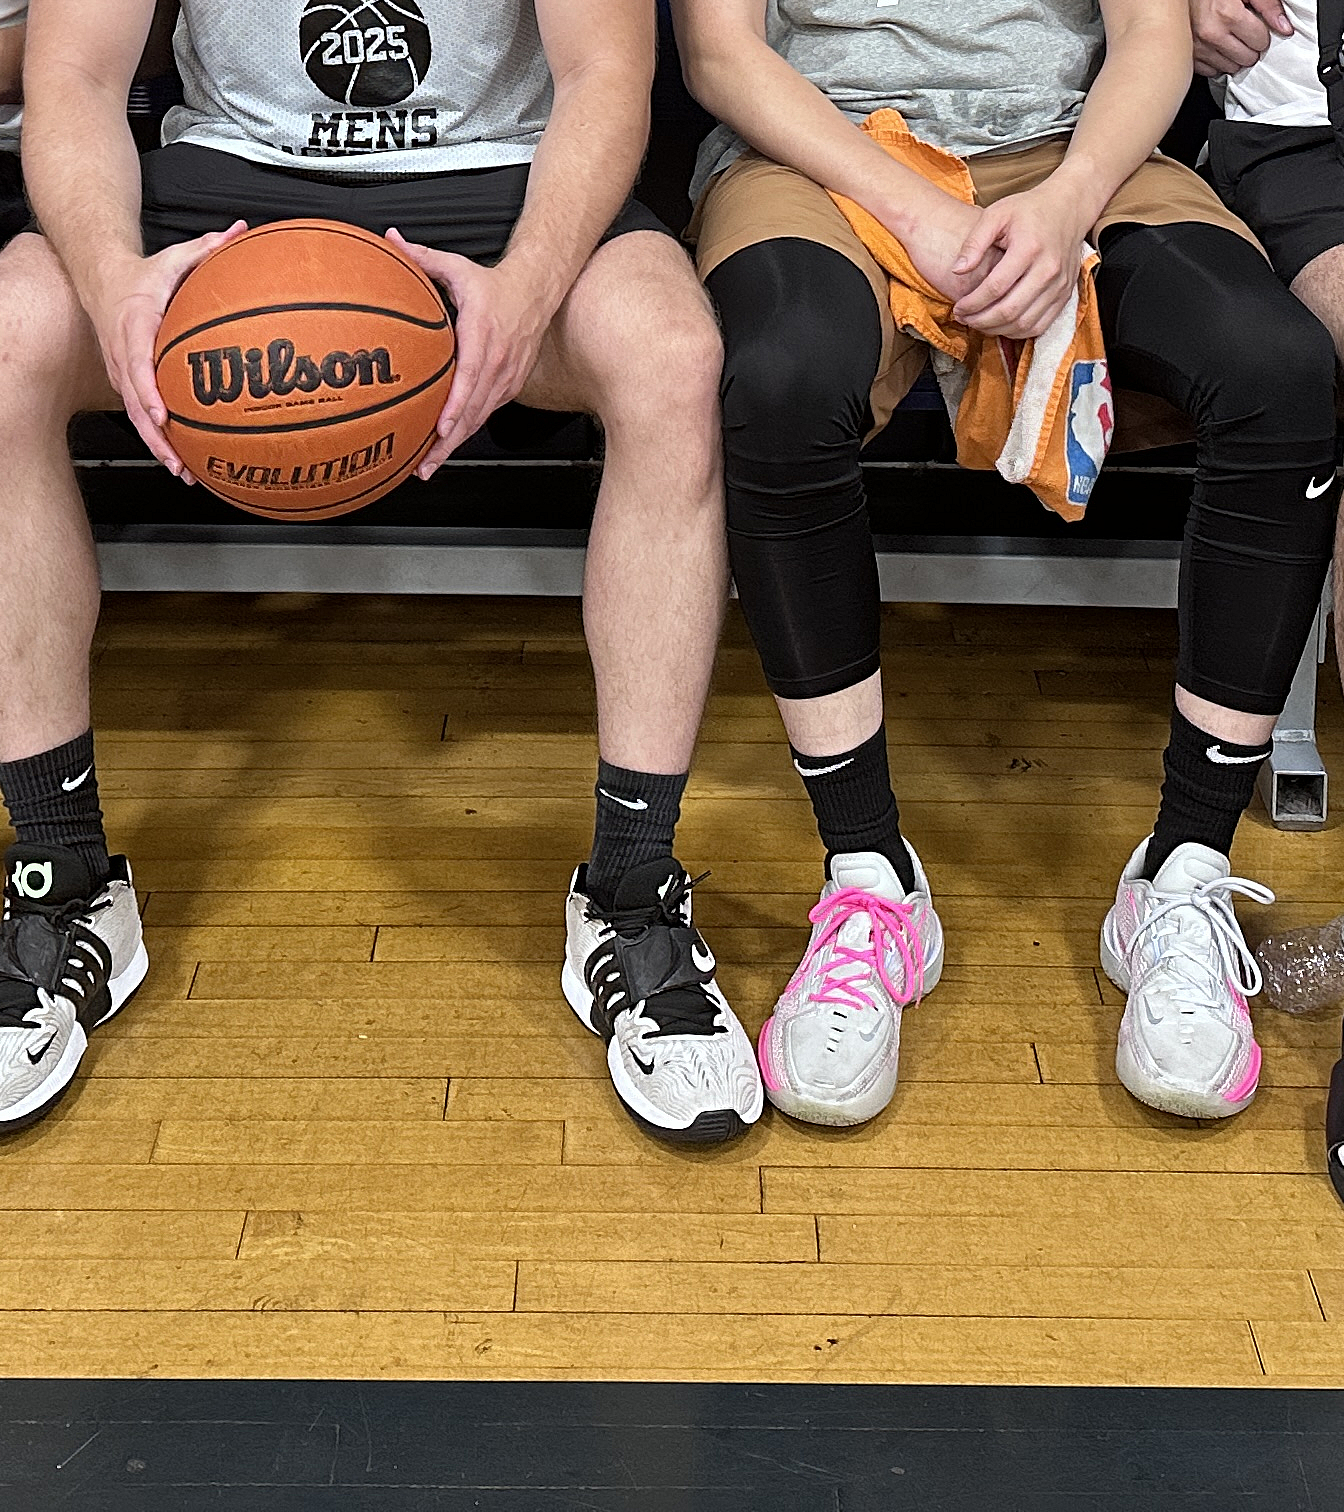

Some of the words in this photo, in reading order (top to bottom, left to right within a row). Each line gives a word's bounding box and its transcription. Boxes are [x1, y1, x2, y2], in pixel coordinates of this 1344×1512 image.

[320, 25, 410, 66] 2025
[308, 107, 439, 150] MENS
[187, 338, 397, 406] Wilson
[206, 431, 396, 486] EVOLUTION
